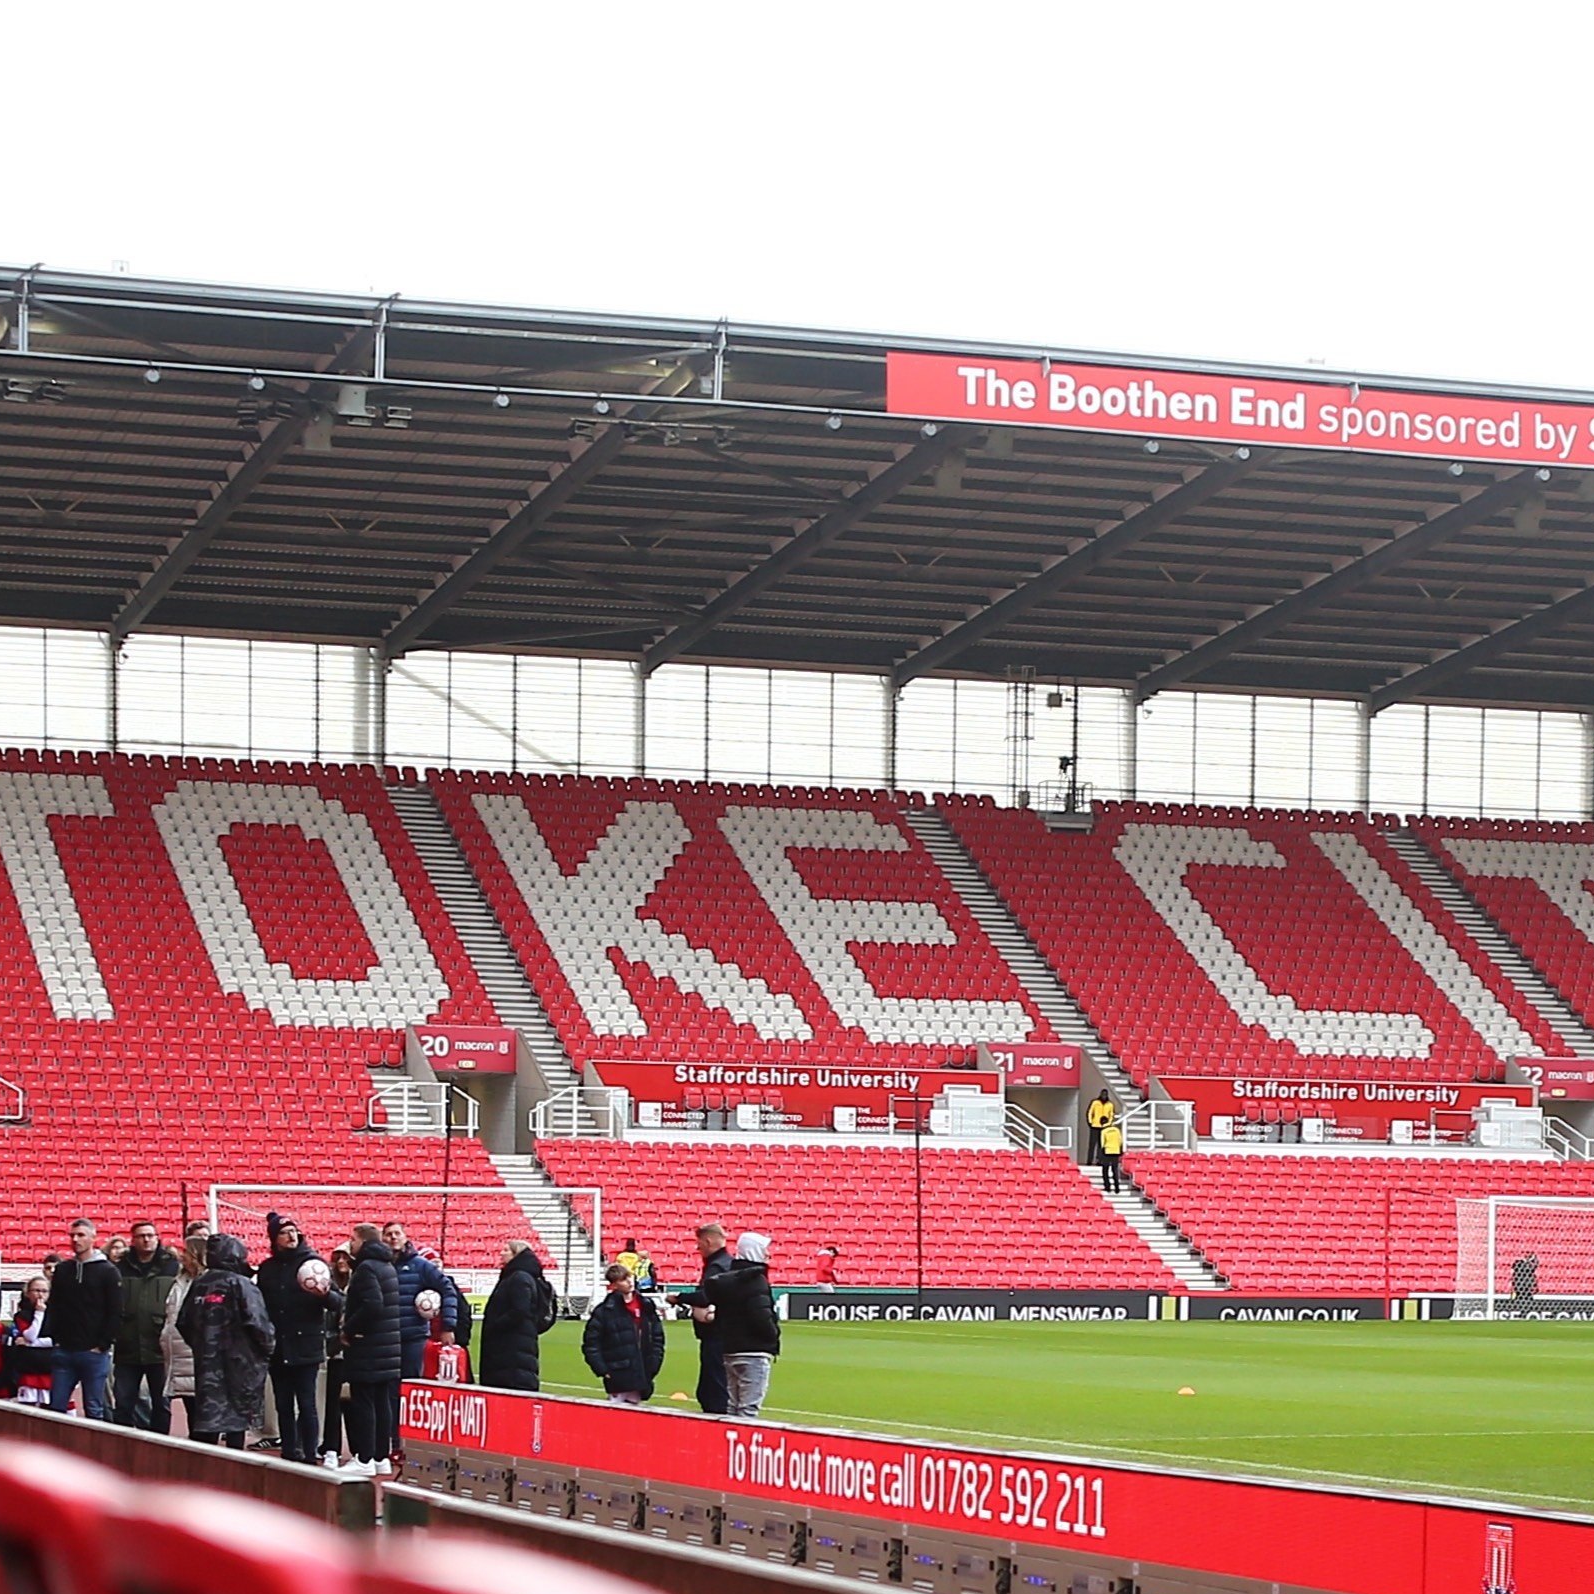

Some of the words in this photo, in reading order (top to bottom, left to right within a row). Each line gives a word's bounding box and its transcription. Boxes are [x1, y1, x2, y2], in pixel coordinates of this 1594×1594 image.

[957, 365, 1036, 409] The
[1047, 373, 1219, 424] Boothen
[1229, 387, 1306, 431] End
[1317, 403, 1520, 449] sponsored
[1533, 413, 1579, 460] by
[420, 1035, 450, 1057] 20
[454, 1040, 495, 1051] macron
[1022, 1056, 1060, 1067] macron
[674, 1065, 810, 1086] Staffordshire
[816, 1068, 920, 1093] University
[1548, 1070, 1583, 1080] macron
[1232, 1080, 1358, 1101] Staffordshire
[1363, 1083, 1459, 1106] University
[808, 1305, 880, 1321] HOUSE
[885, 1305, 915, 1321] OF
[920, 1305, 995, 1321] CAVANI
[1010, 1306, 1128, 1322] MENSWEAR
[409, 1389, 446, 1441] £55pp
[448, 1393, 487, 1448] (+VAT)
[725, 1430, 746, 1481] To
[750, 1432, 786, 1489] find
[788, 1446, 822, 1495] out
[825, 1455, 876, 1502] more
[880, 1452, 915, 1508] call
[920, 1456, 993, 1521] 01782
[1000, 1465, 1048, 1530] 592
[1054, 1471, 1107, 1538] 211
